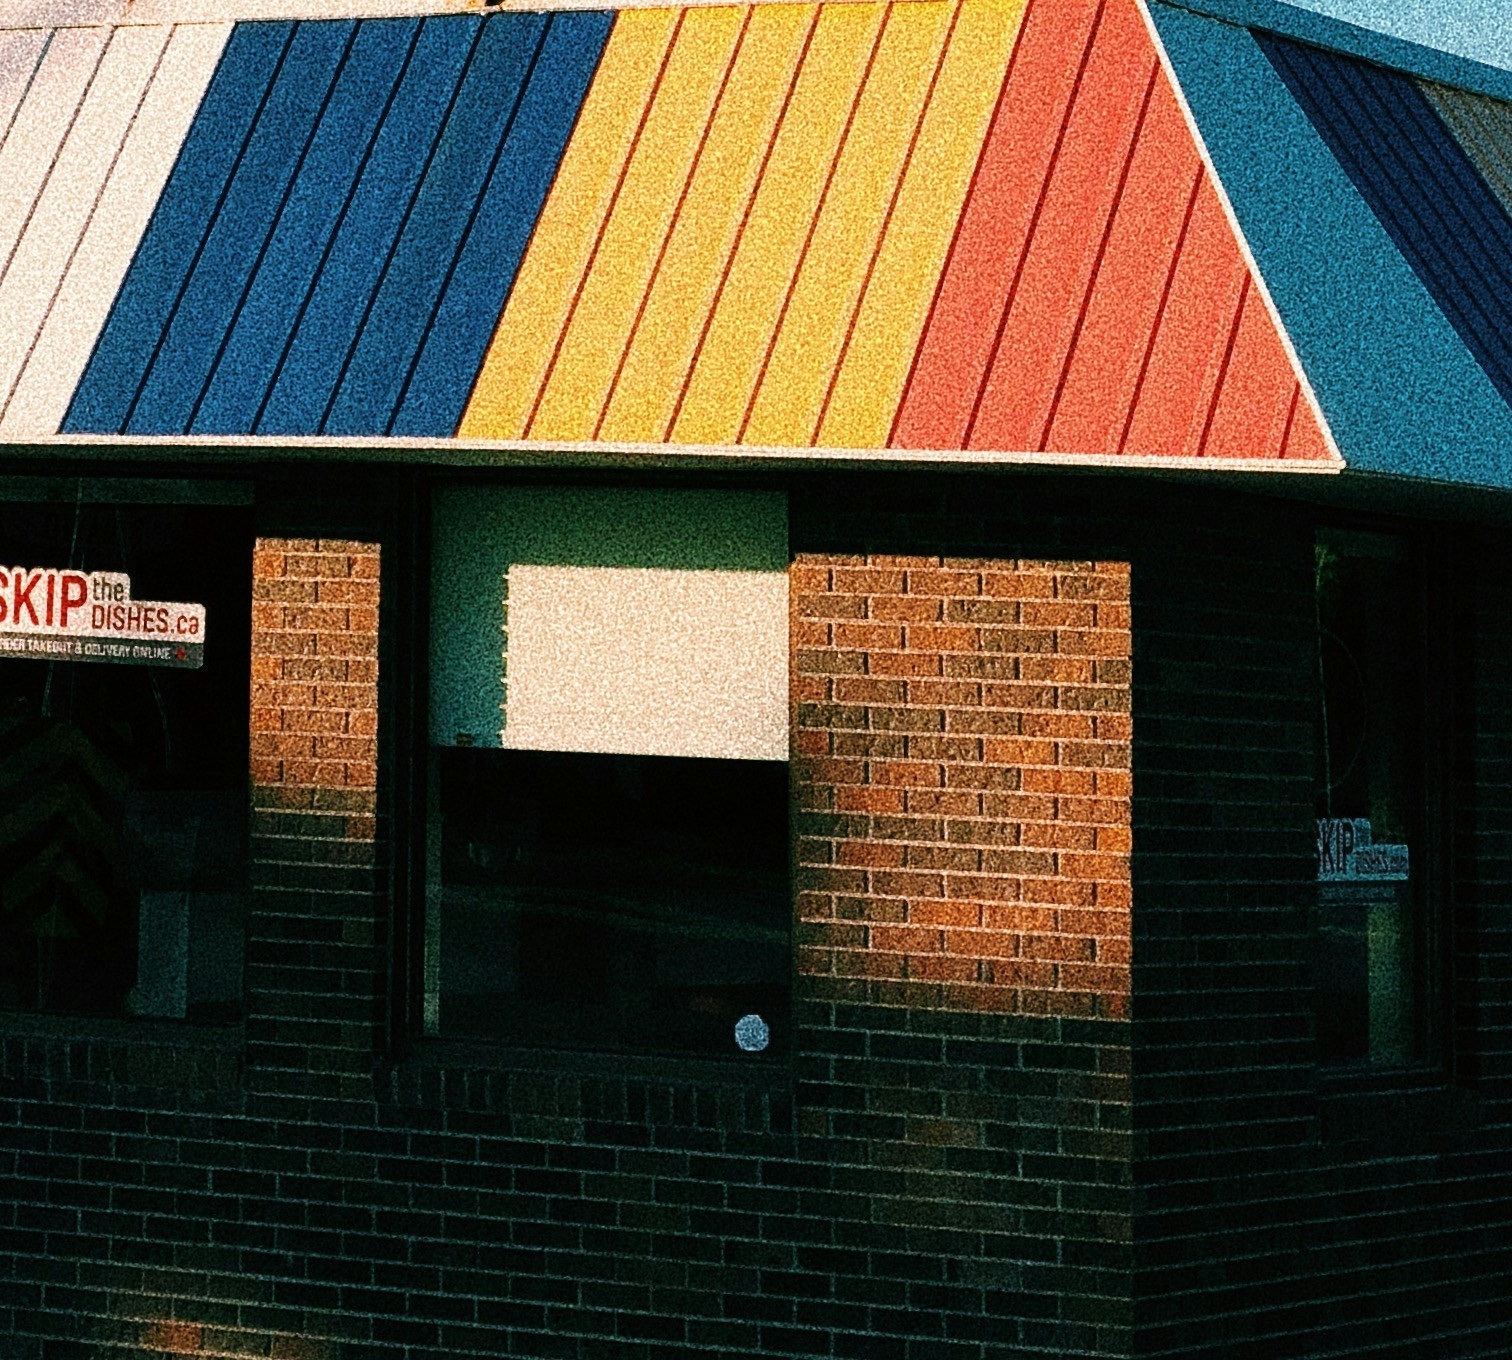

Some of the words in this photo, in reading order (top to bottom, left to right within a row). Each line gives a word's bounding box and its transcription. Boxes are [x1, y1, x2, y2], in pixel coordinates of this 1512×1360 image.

[92, 577, 124, 602] the
[91, 605, 199, 635] DISHES.ca
[27, 639, 73, 654] TAKEOUT
[75, 642, 83, 655] &
[85, 643, 130, 658] DELIVERY
[132, 646, 172, 660] ONLINE
[1316, 821, 1355, 875] KIP
